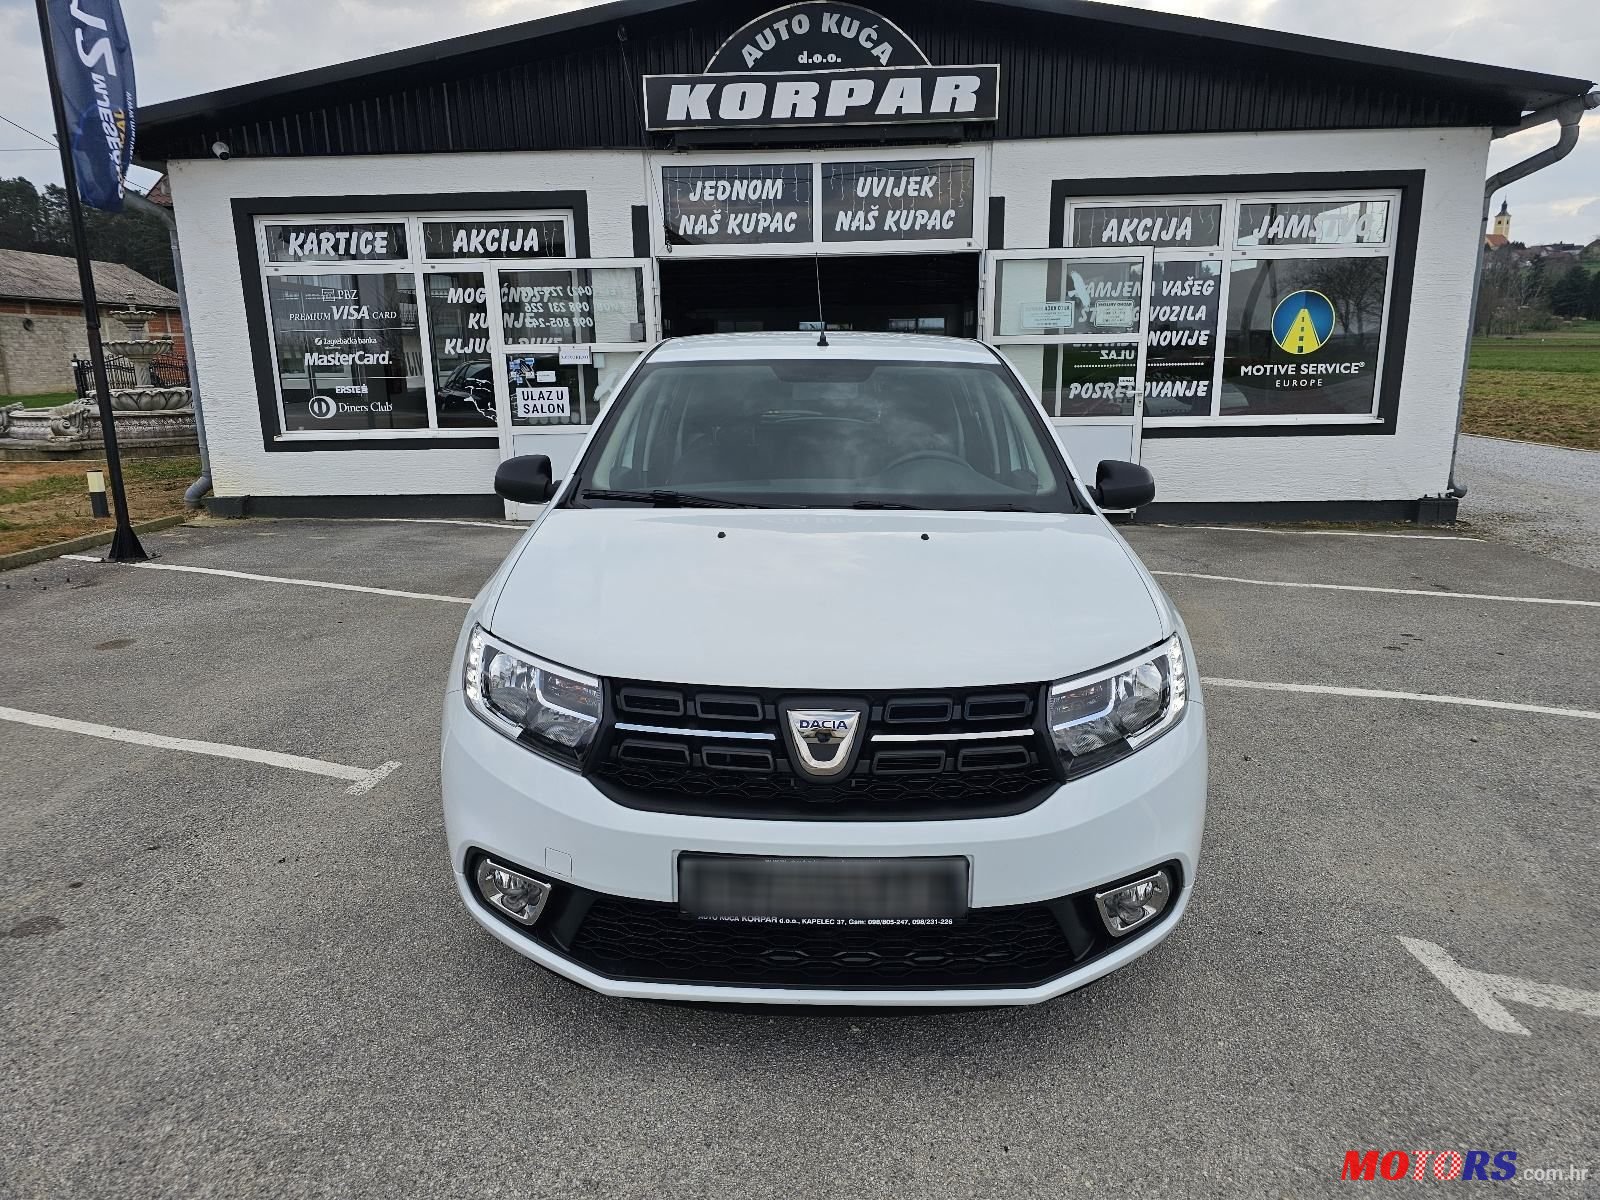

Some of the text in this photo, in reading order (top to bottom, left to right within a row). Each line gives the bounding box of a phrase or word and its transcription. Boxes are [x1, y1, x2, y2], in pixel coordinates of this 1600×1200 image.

[741, 12, 893, 68] AUTO KUĆA
[797, 51, 842, 64] d.o.o.
[666, 75, 981, 121] KORPAR
[689, 178, 783, 202] JEDNOM
[856, 175, 938, 199] UVIJEK
[679, 209, 798, 236] NAŠ KUPAC
[835, 205, 956, 233] NAŠ KUPAC
[1102, 216, 1192, 243] AKCIJA
[288, 231, 388, 257] KARTICE
[453, 228, 539, 253] AKCIJA
[338, 289, 358, 300] PBZ
[447, 282, 555, 304] MOGĆNOST
[1084, 276, 1215, 298] AMJEN VAŠEG
[289, 305, 397, 321] PREMIUM VISA CARD
[468, 312, 535, 330] KUNJE
[1149, 305, 1207, 322] VOZILA
[1148, 330, 1210, 346] NOVIJE
[1240, 363, 1297, 377] MOTIVE
[335, 386, 361, 394] ERSTE
[1275, 378, 1324, 388] EUROPE
[522, 390, 564, 401] ULAZ U
[339, 401, 392, 412] Diners Club
[523, 404, 565, 414] SALON
[799, 720, 848, 730] DACIA
[741, 916, 778, 924] KORPAR
